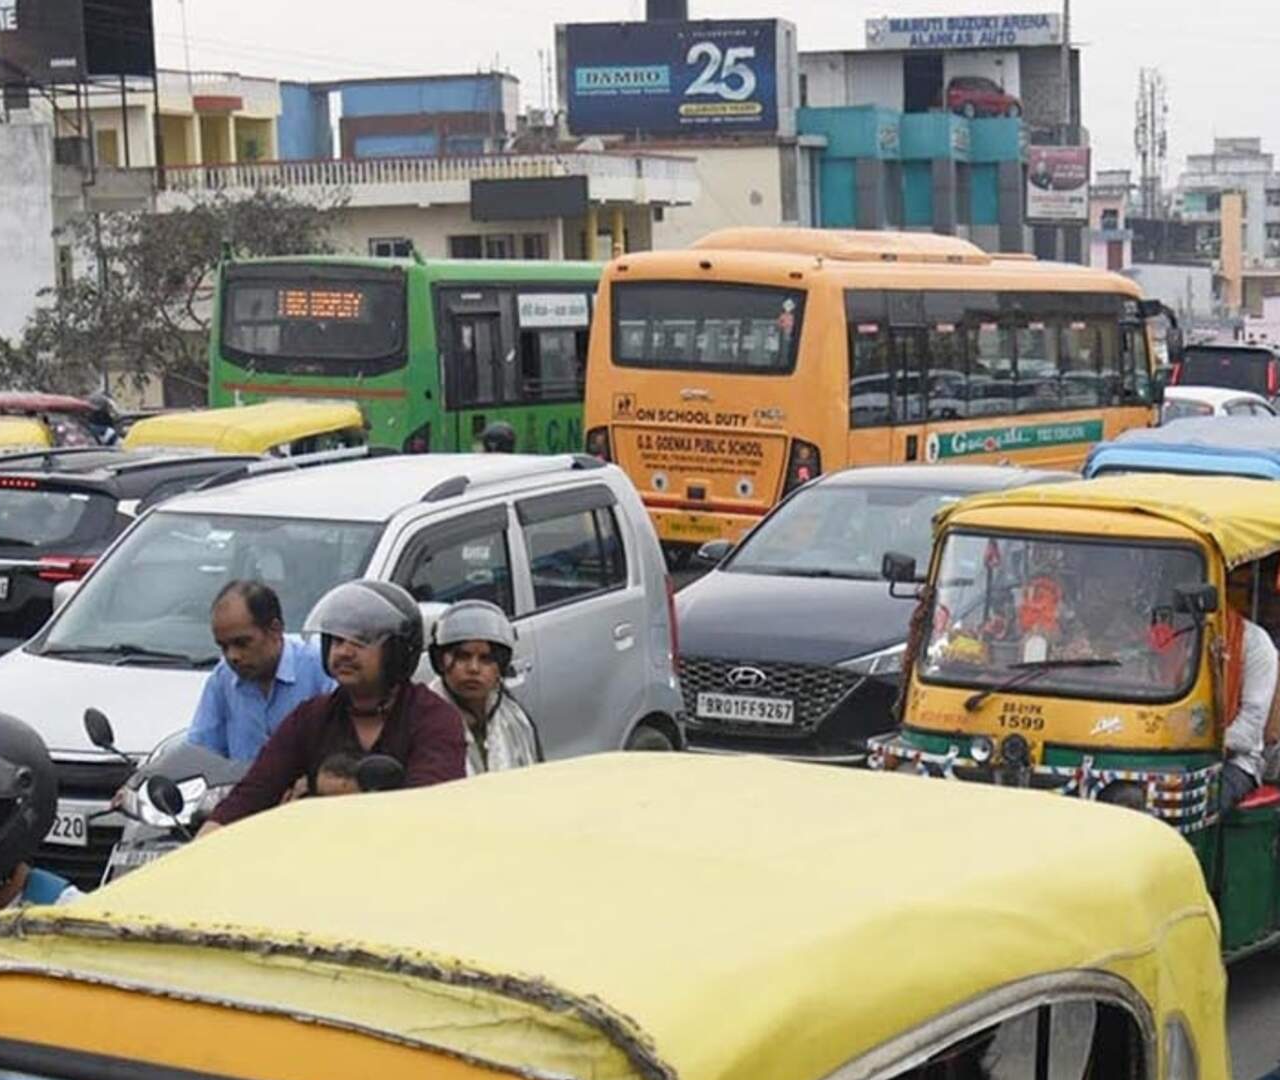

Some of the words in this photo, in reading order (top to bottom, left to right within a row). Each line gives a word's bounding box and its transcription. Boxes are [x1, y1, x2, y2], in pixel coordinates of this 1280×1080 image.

[979, 31, 1017, 45] AUTO
[585, 70, 661, 85] DAMRO
[685, 41, 757, 100] 25
[636, 408, 657, 421] ON
[659, 410, 711, 425] SCHOOL
[715, 412, 749, 426] DUTY
[694, 437, 726, 454] PUBLIC
[728, 439, 763, 458] SCHOOL
[997, 714, 1046, 731] 1599
